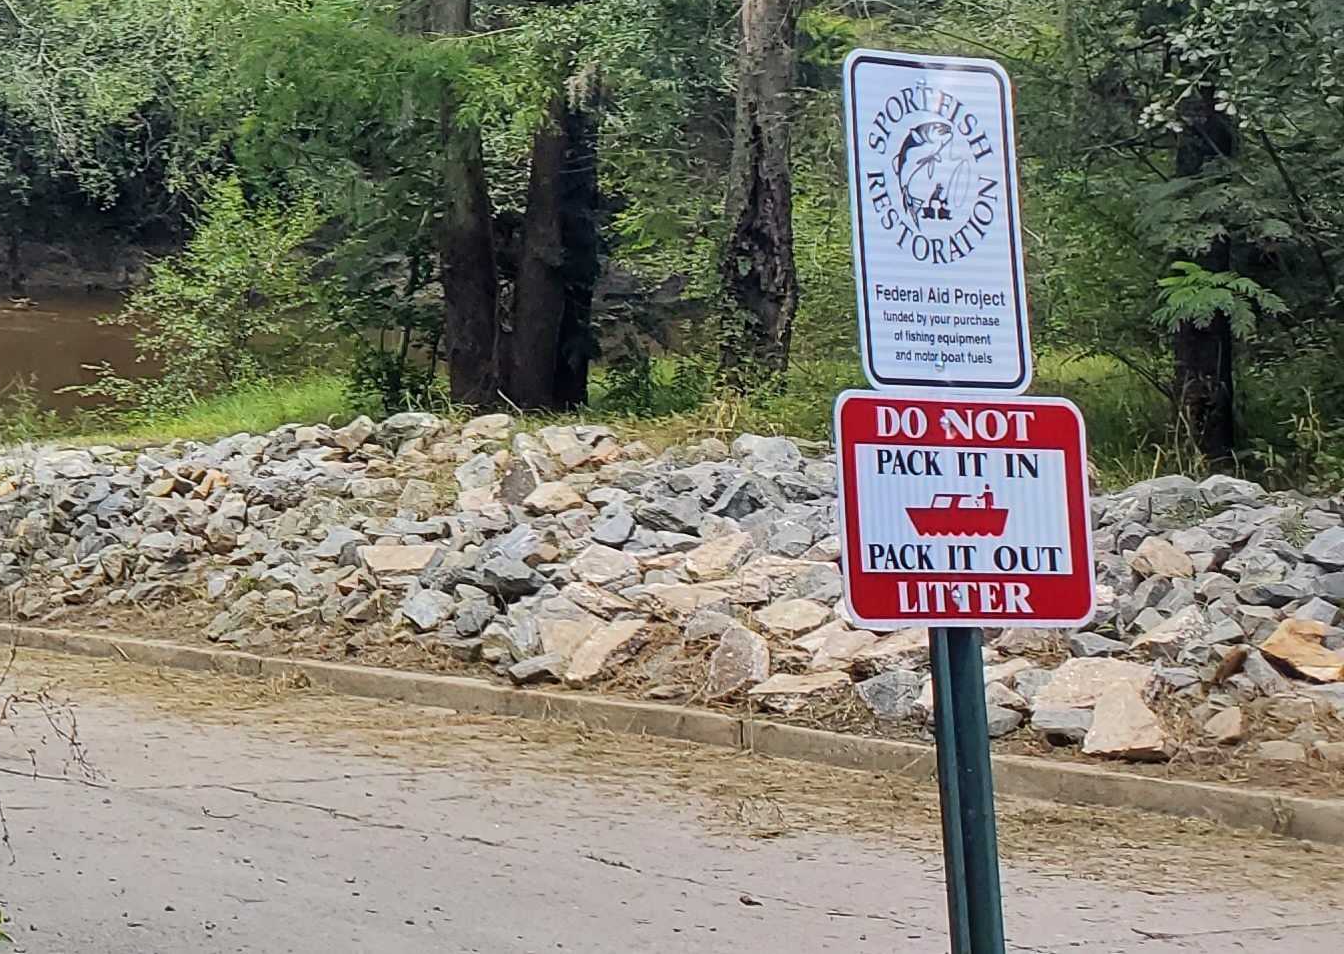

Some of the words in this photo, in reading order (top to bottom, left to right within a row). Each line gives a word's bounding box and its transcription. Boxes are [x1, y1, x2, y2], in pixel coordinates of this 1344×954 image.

[868, 83, 933, 155] SPORT
[937, 88, 994, 163] FISH
[866, 170, 999, 264] RESTORATION
[875, 284, 923, 303] Federal
[927, 287, 950, 304] Aid
[954, 289, 1006, 308] Project
[883, 310, 915, 323] funded
[916, 312, 927, 326] by
[929, 314, 950, 327] your
[953, 314, 1000, 328] purchase
[894, 331, 903, 341] of
[905, 330, 935, 345] fishing
[937, 331, 991, 347] equipment
[895, 350, 912, 362] and
[914, 350, 938, 362] motor
[941, 352, 965, 363] boat
[968, 352, 993, 364] fuels
[876, 406, 928, 439] DO
[942, 409, 1035, 441] NOT
[877, 449, 943, 475] PACK
[957, 451, 987, 477] IT
[1006, 453, 1038, 478] IN
[868, 544, 935, 570] PACK
[948, 545, 977, 571] IT
[993, 546, 1062, 571] OUT
[897, 581, 1034, 613] LITTER
